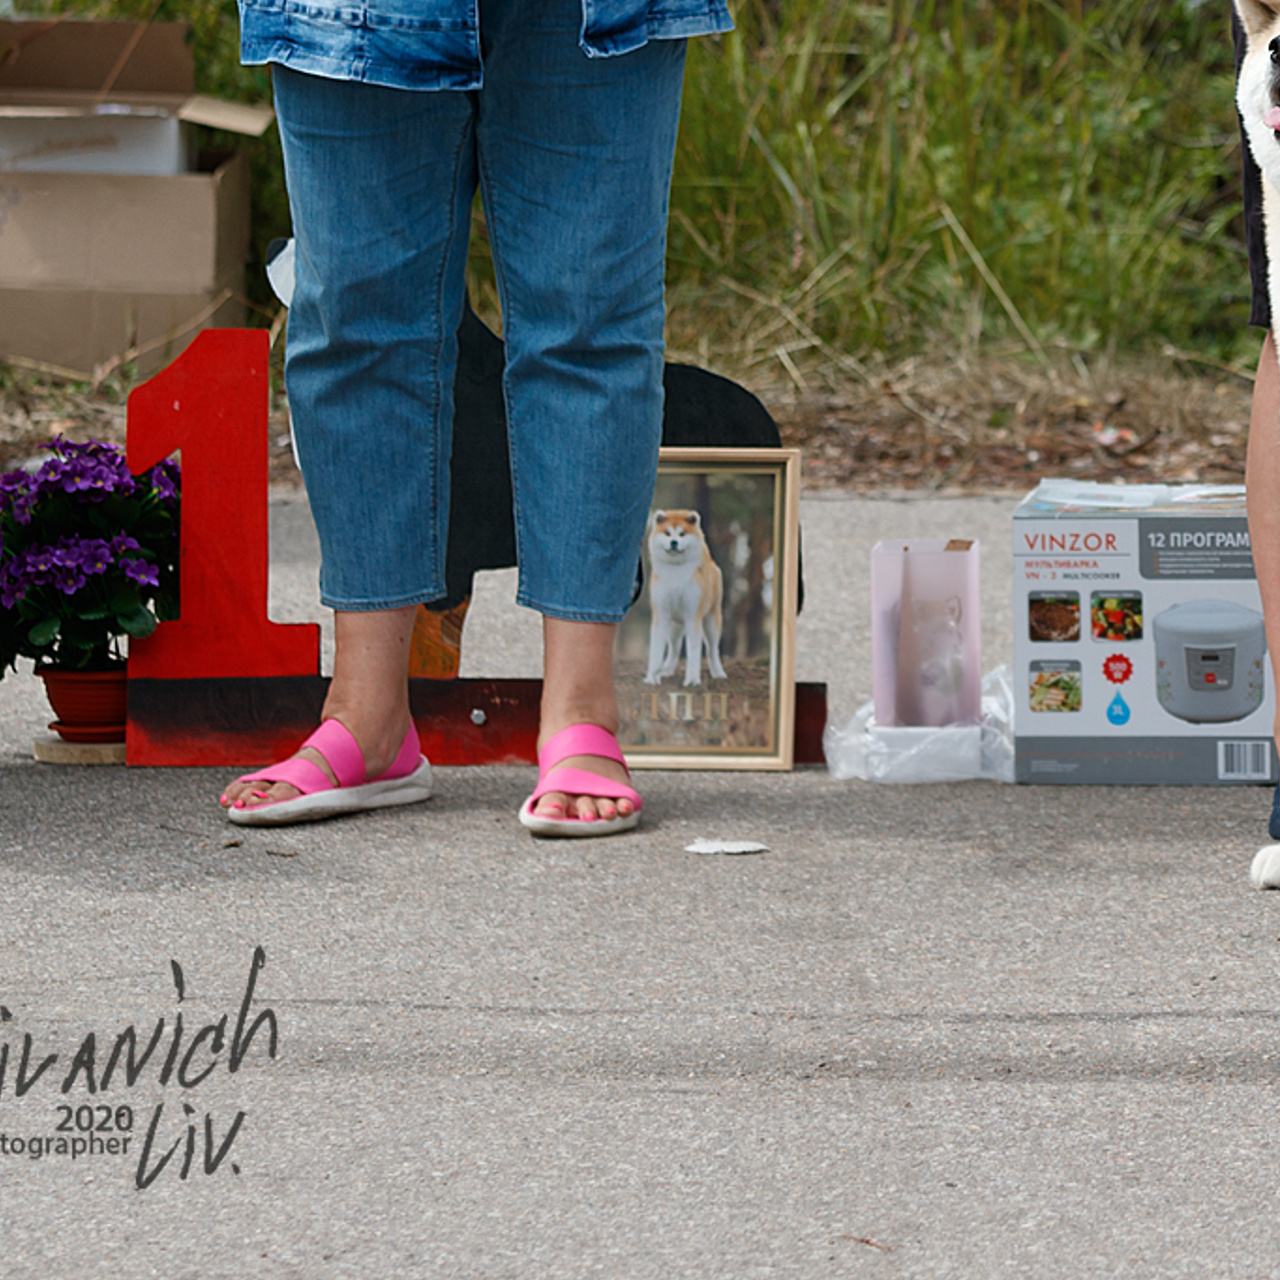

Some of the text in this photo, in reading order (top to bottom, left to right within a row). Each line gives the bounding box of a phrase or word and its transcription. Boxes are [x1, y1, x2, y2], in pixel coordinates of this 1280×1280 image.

[1023, 532, 1119, 552] VINZOR
[1147, 532, 1166, 548] 12
[1024, 559, 1100, 569] МУЛЬТИВАРКА
